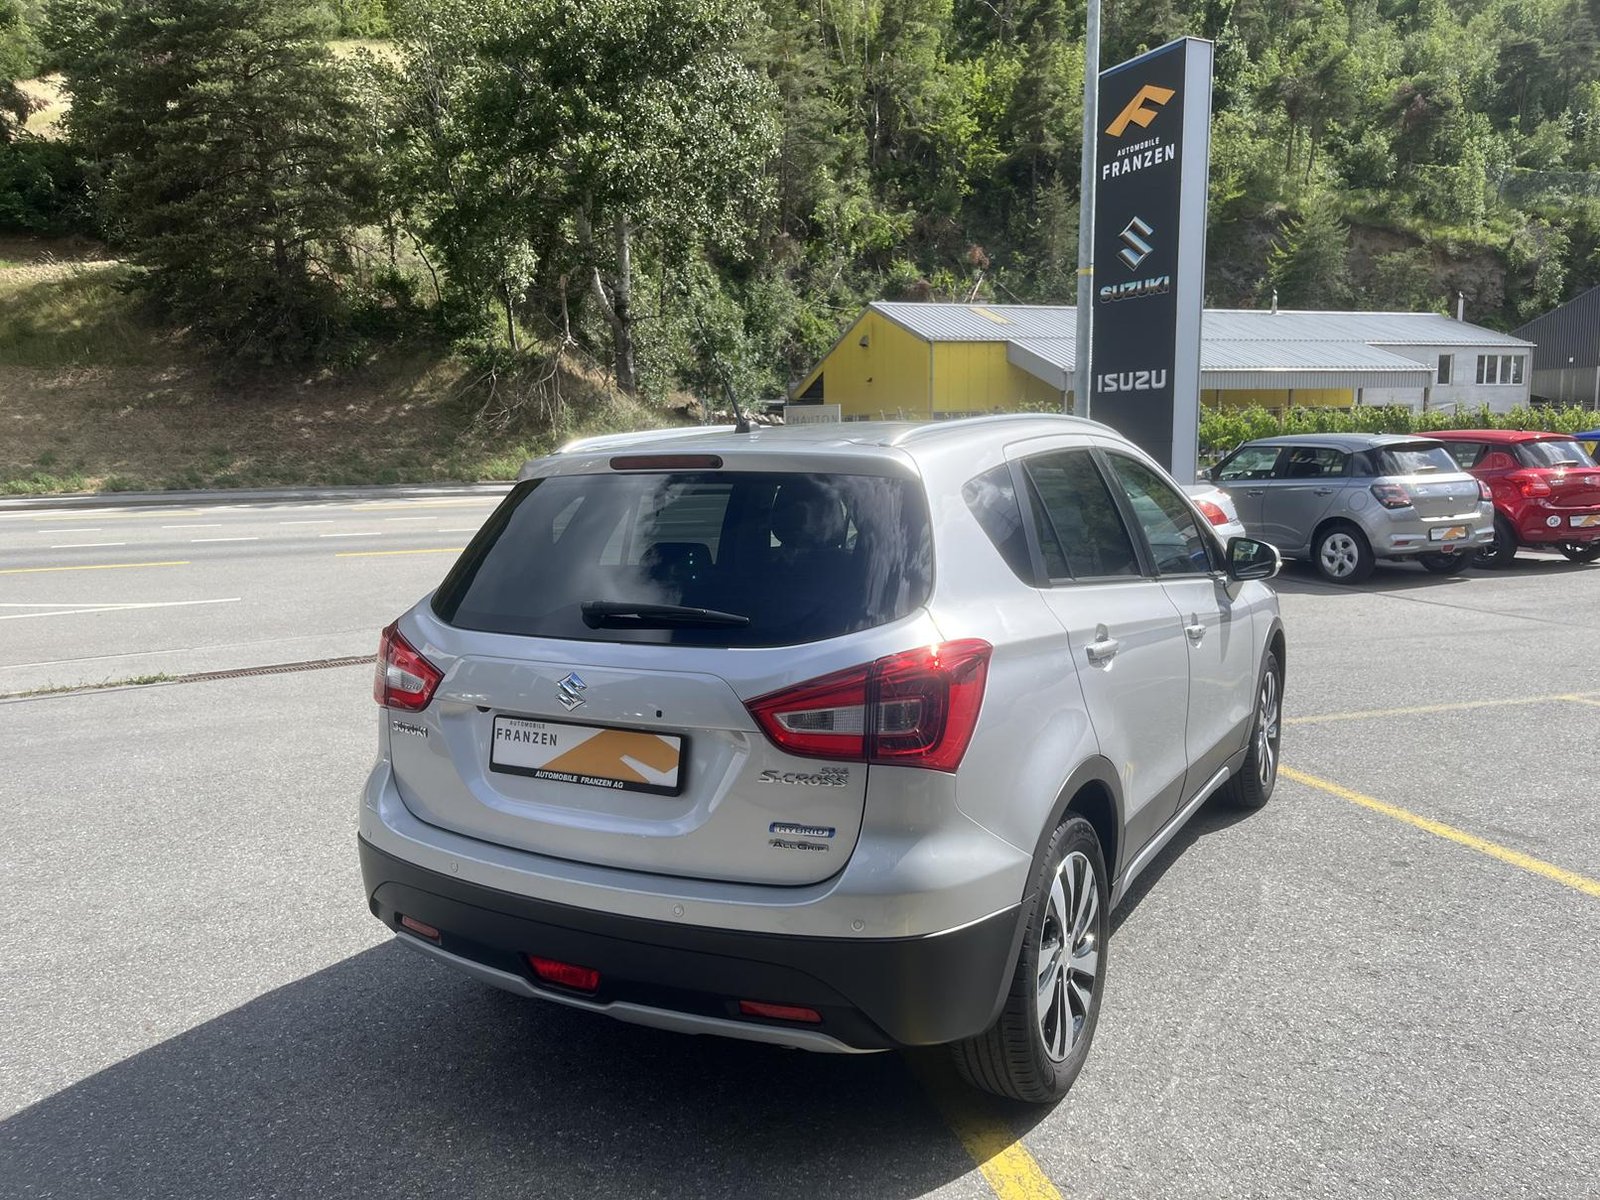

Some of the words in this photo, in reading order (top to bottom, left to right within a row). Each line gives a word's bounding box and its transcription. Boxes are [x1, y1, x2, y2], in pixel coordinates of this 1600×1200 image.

[1117, 136, 1160, 157] AUTOMOBILE
[1102, 143, 1175, 180] FRANZEN
[1100, 276, 1170, 304] SUZUKI
[1097, 369, 1167, 393] ISUZU
[392, 719, 428, 738] SUZUKI
[509, 720, 546, 730] AUTOMOBILE
[496, 728, 557, 746] FRANZEN
[535, 770, 578, 783] AUTOMOBILE
[580, 776, 612, 787] FRANZEN
[612, 781, 624, 789] AG
[774, 825, 830, 837] HYBRID
